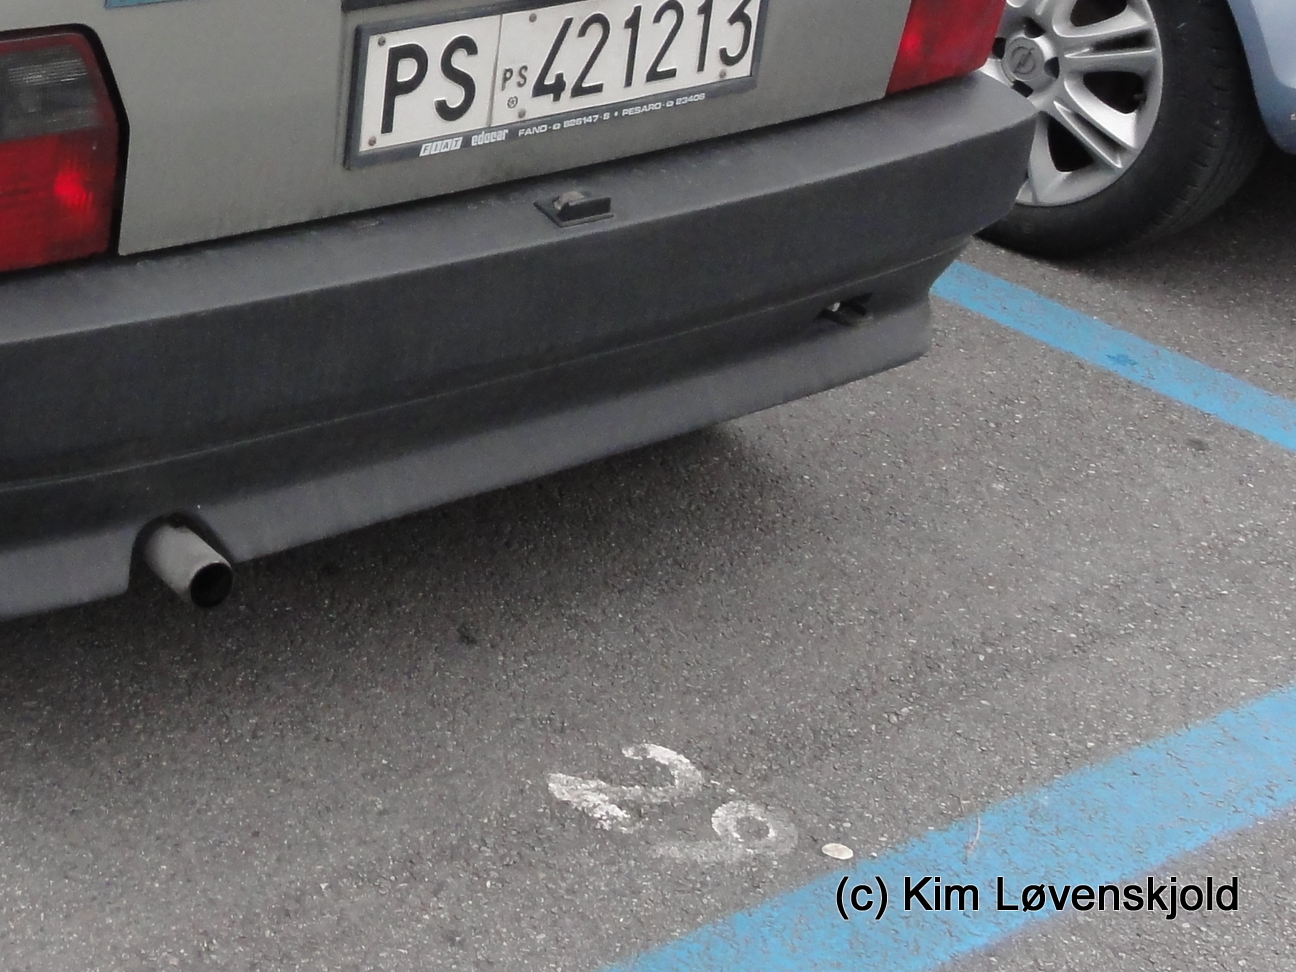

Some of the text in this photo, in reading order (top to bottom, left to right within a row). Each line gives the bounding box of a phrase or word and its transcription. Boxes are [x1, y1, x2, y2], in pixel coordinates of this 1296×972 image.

[380, 35, 478, 135] PS
[501, 64, 529, 91] PS
[419, 137, 463, 157] FIAT
